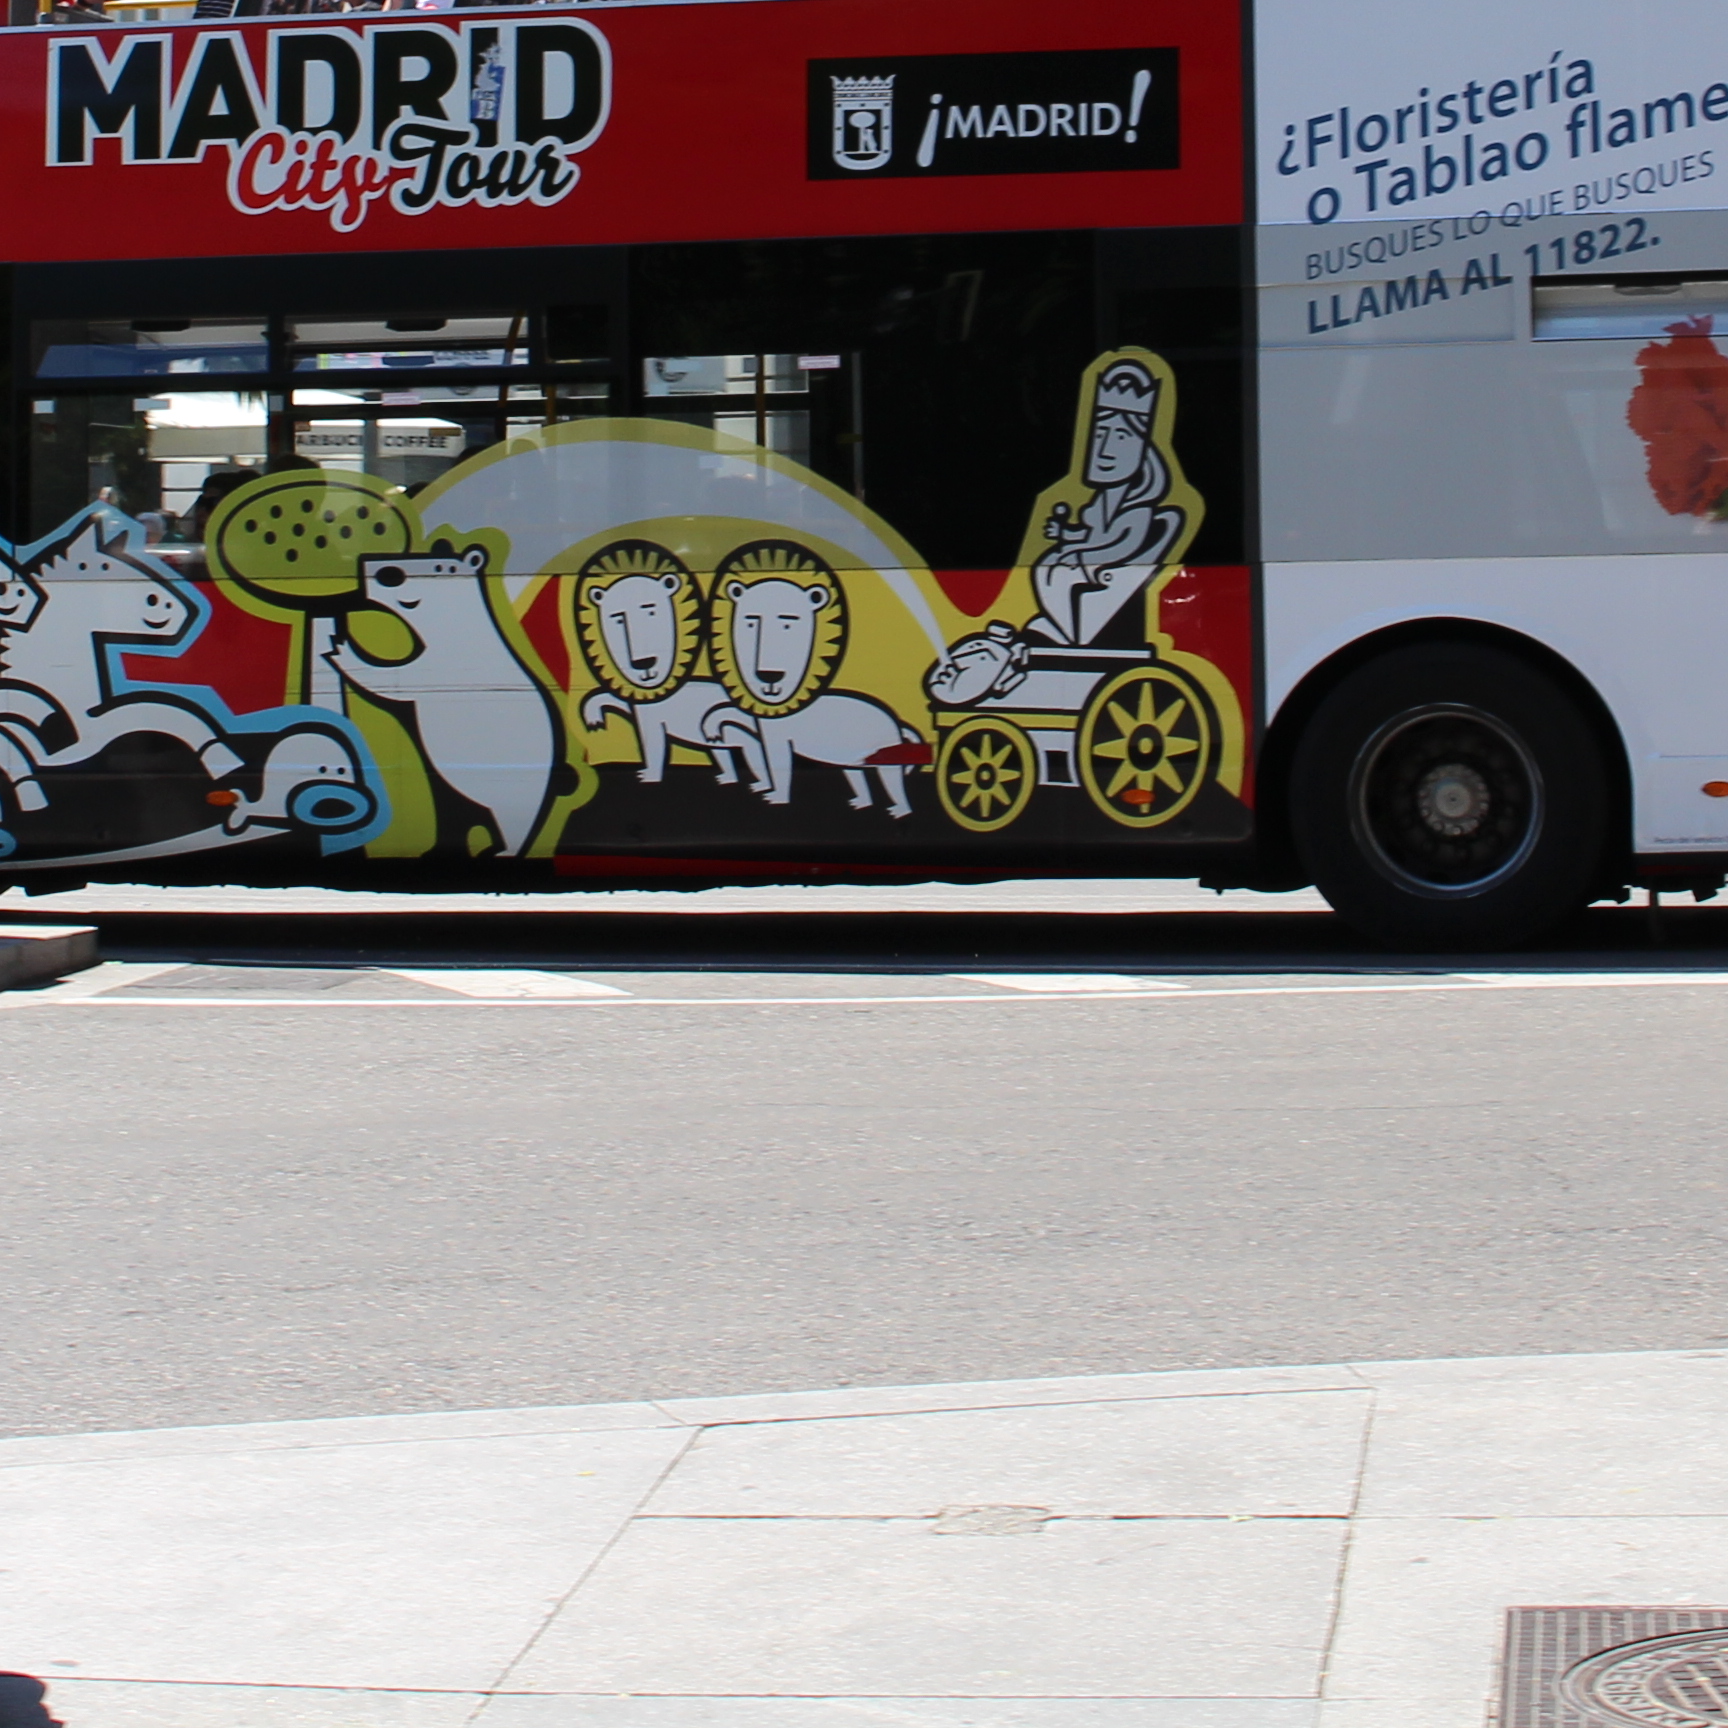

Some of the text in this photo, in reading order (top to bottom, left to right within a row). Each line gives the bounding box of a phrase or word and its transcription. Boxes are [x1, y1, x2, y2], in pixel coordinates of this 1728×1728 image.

[50, 21, 610, 165] MADRID
[916, 69, 1152, 168] ¡MADRID!
[1276, 49, 1595, 176] ¿Floristería
[232, 122, 575, 227] City Tour
[1305, 150, 1715, 280] BUSQUES LO QUE BUSQUES
[1306, 185, 1341, 225] o
[1354, 130, 1549, 213] Tablao
[1308, 268, 1450, 335] LLAMA
[1460, 252, 1513, 295] AL
[383, 435, 448, 448] COFFEE
